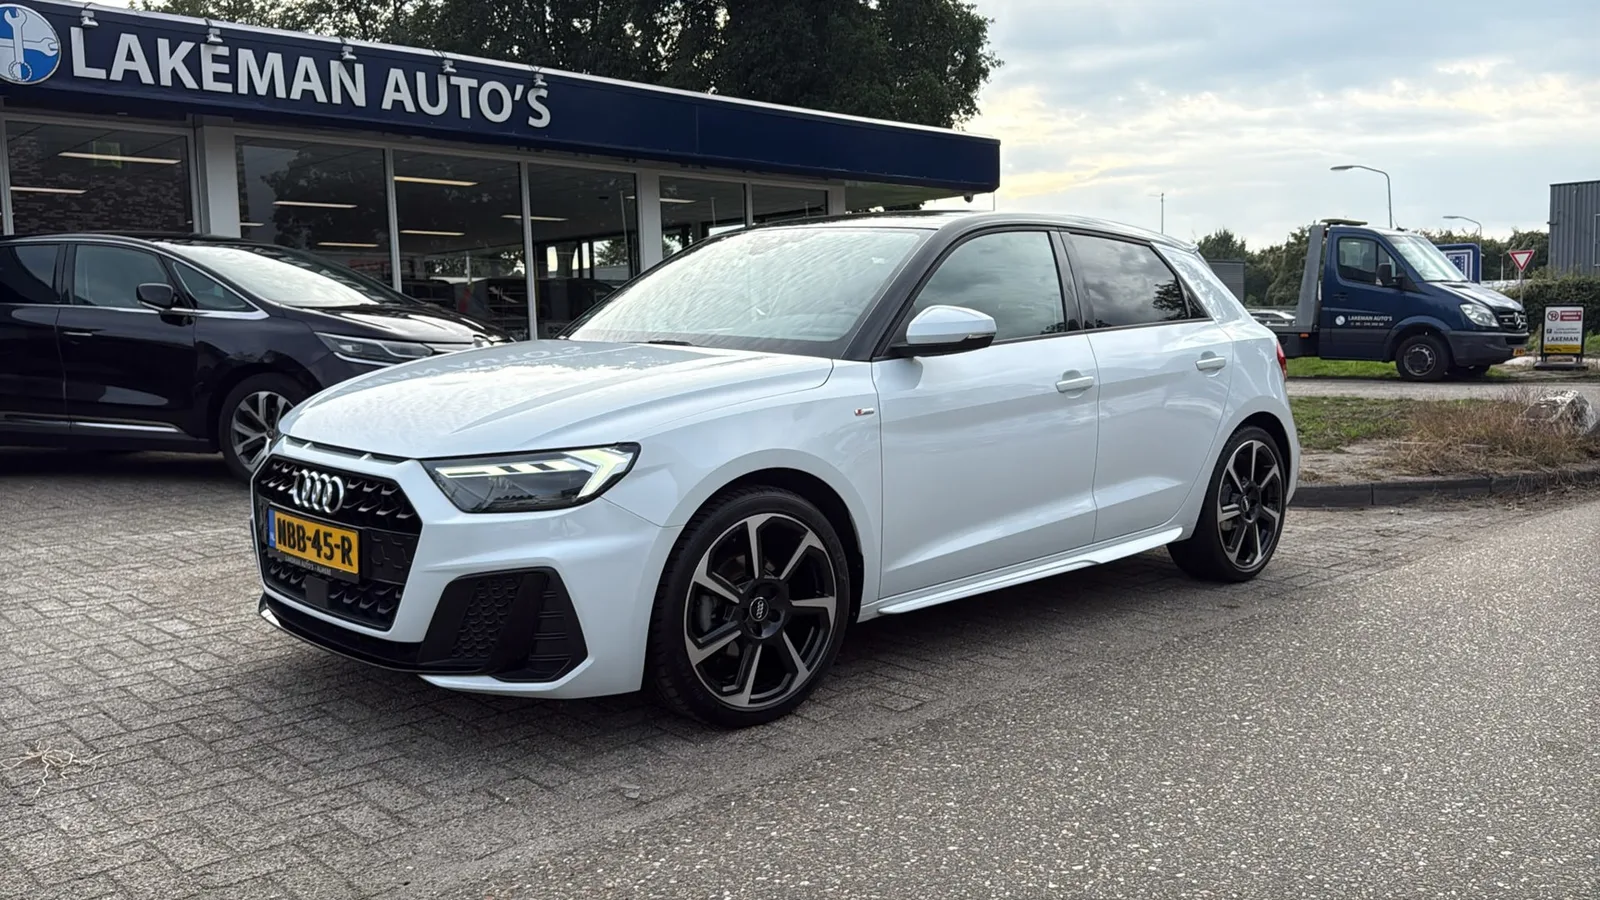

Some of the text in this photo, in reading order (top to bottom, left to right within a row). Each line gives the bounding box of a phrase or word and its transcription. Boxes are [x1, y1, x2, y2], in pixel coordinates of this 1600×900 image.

[70, 26, 551, 128] LAKEMAN AUTO'S
[277, 518, 353, 566] NBB-45-R
